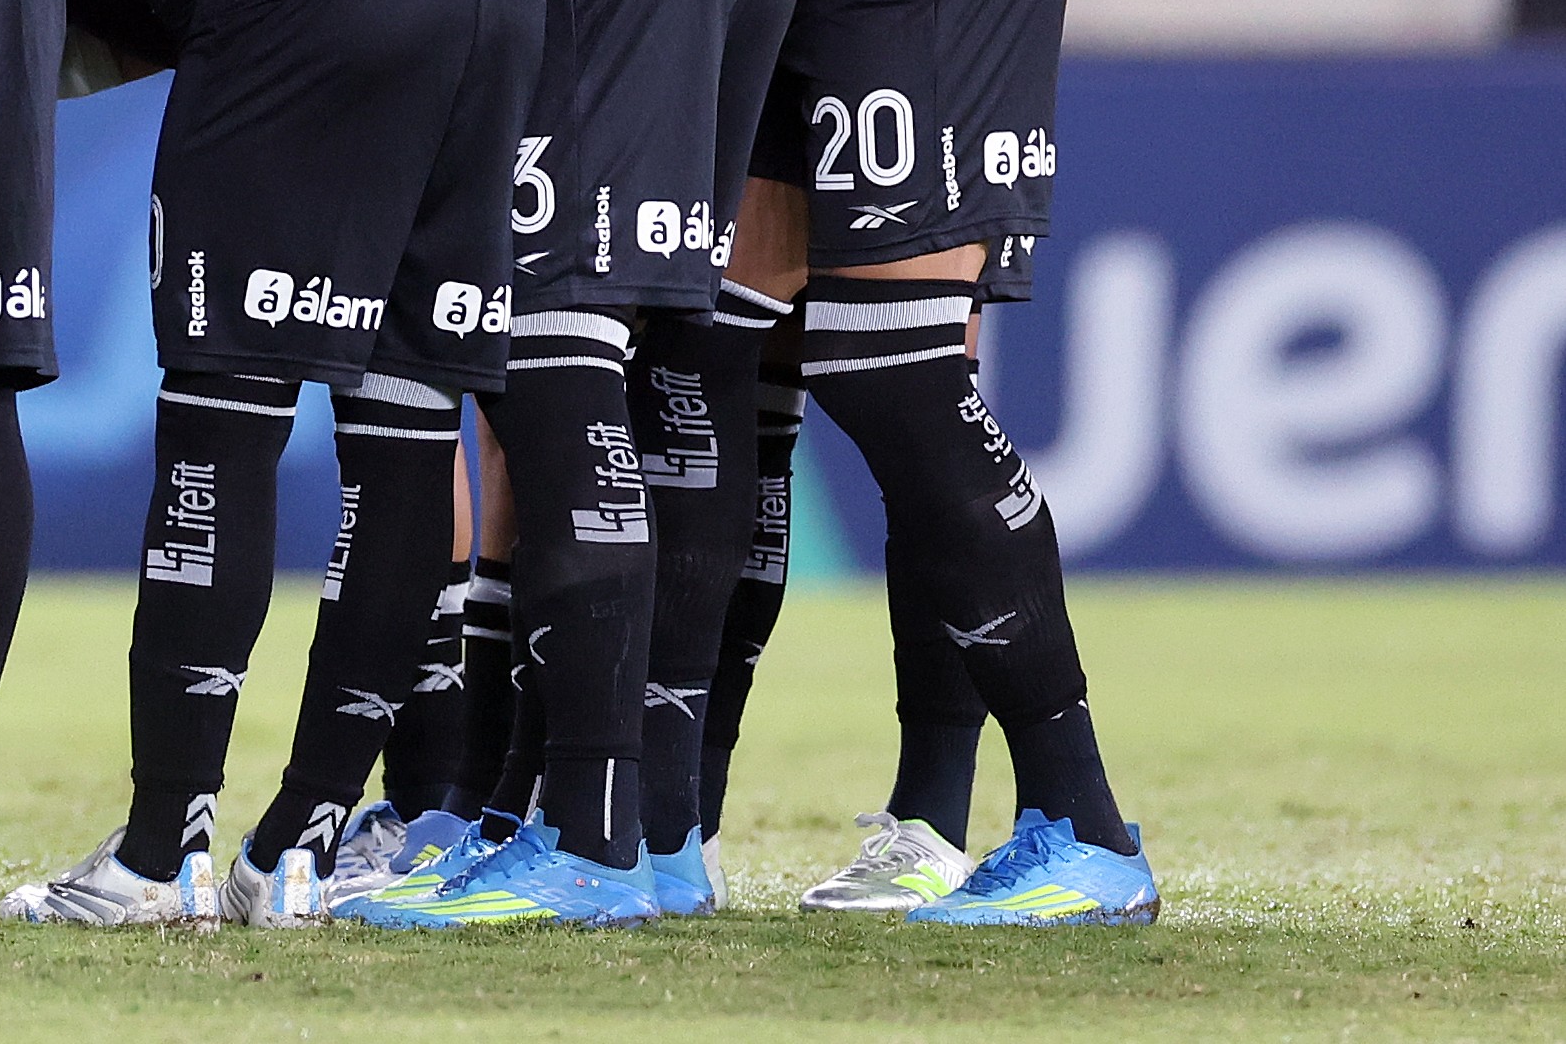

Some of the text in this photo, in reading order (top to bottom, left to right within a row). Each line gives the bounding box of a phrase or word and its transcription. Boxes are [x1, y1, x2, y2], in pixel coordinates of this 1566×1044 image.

[811, 88, 915, 191] 20
[941, 126, 962, 211] Reebok
[1022, 128, 1056, 178] ála
[594, 185, 612, 273] Reebok
[188, 251, 208, 337] Reebok
[293, 276, 387, 331] álam
[650, 366, 719, 458] Lifefit
[165, 460, 216, 554] Lifefit
[586, 420, 646, 511] Lifefit
